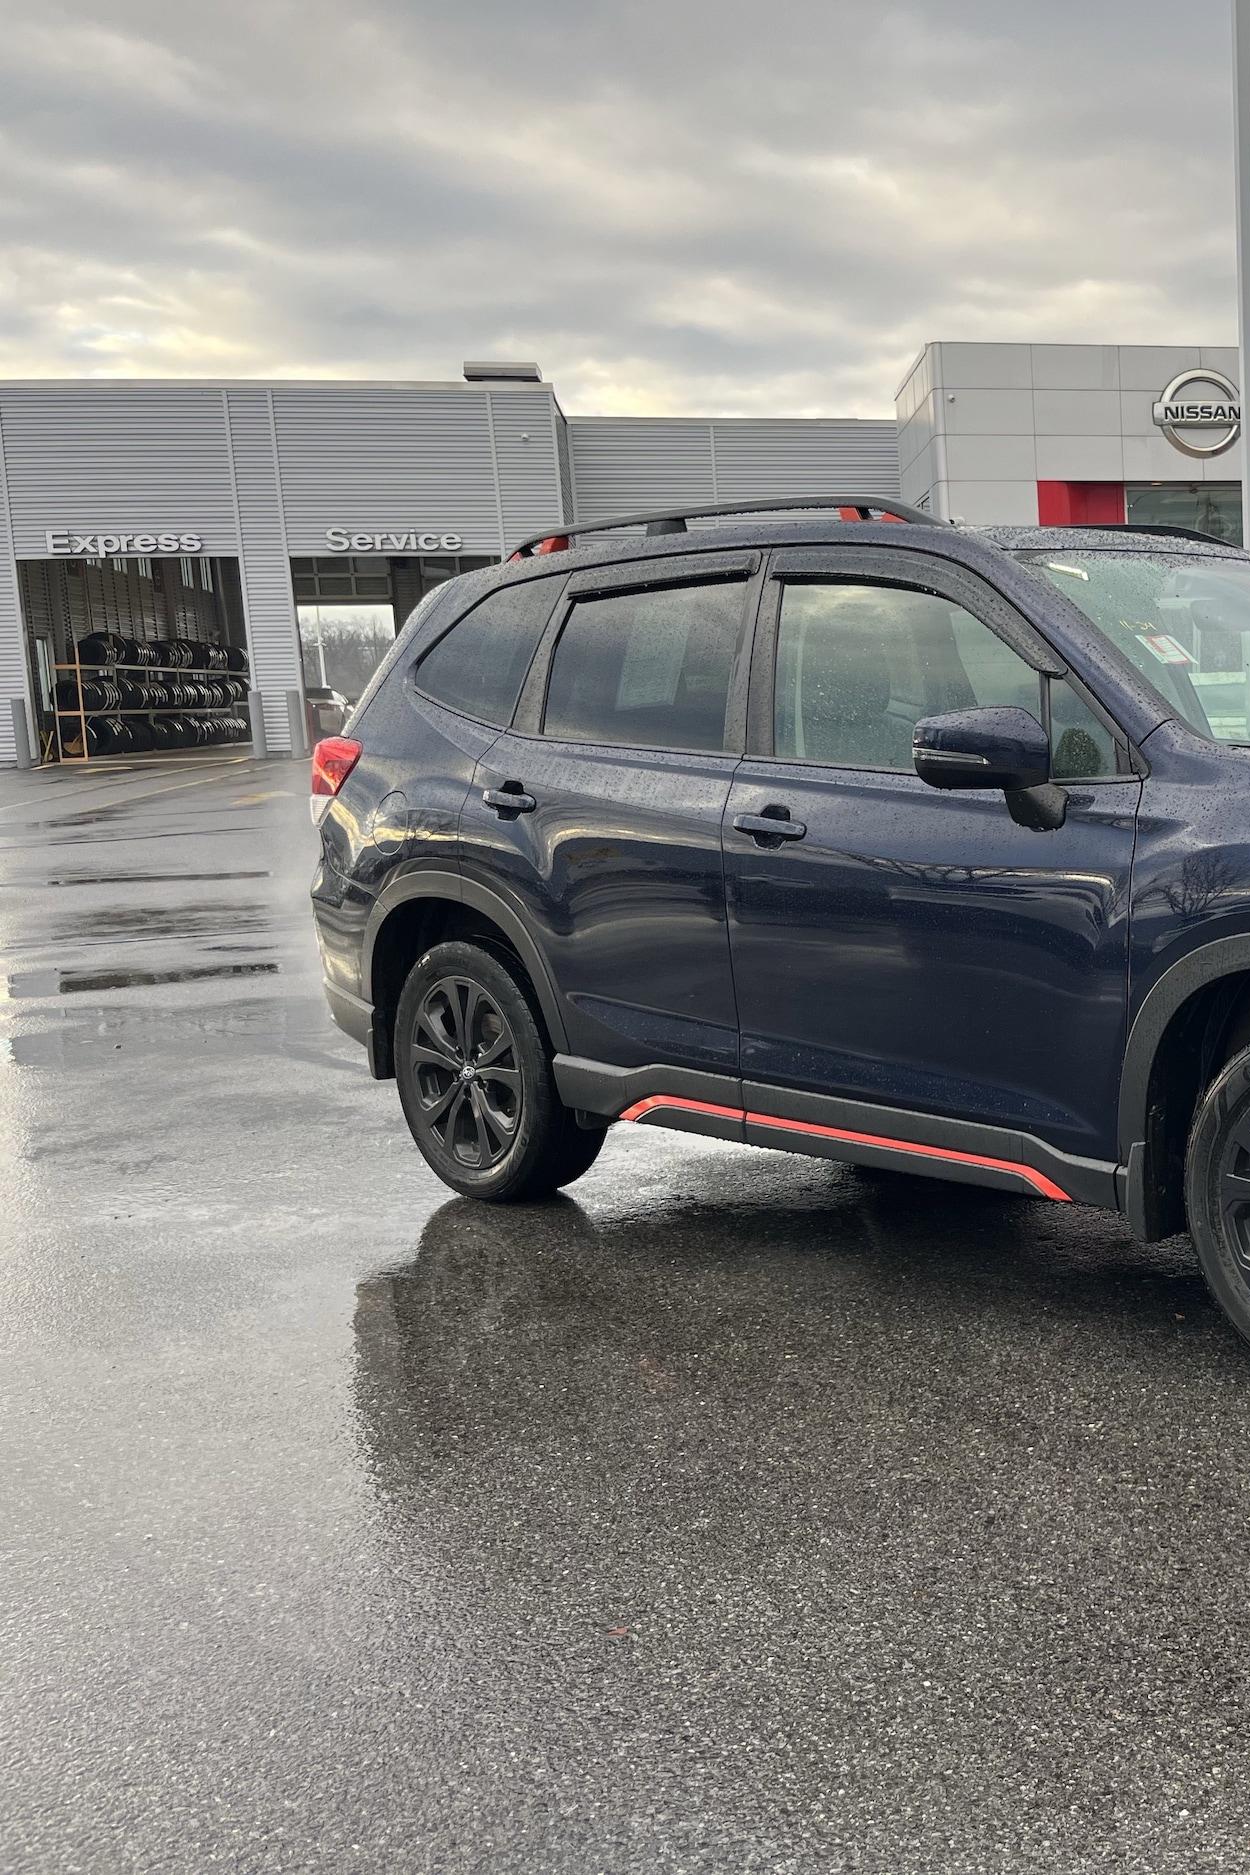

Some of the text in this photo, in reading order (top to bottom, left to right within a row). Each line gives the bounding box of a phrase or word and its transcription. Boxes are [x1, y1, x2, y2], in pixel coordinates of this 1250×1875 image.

[1164, 405, 1240, 420] NISSAN
[45, 530, 202, 558] Express
[325, 527, 463, 551] Service
